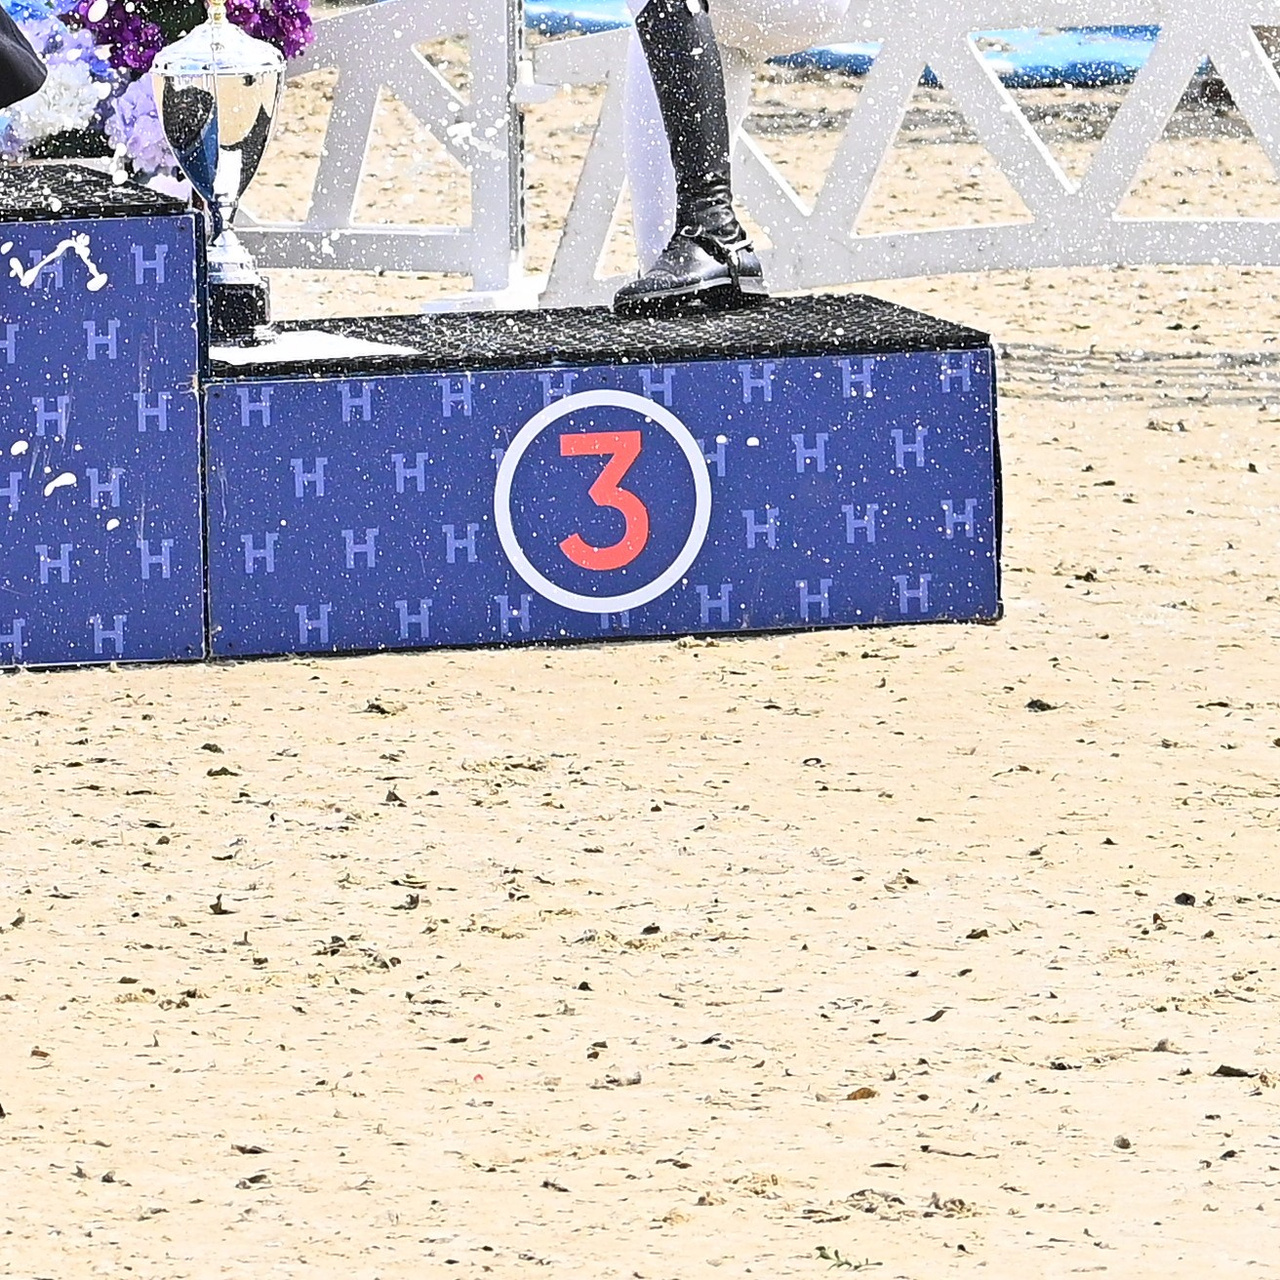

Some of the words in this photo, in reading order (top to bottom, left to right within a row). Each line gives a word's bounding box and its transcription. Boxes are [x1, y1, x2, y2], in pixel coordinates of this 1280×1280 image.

[30, 250, 65, 290] H
[132, 245, 169, 285] H
[84, 320, 121, 361] H
[538, 372, 576, 407] H
[639, 367, 676, 407] H
[739, 363, 778, 404] H
[840, 358, 877, 398] H
[940, 354, 974, 394] H
[33, 395, 72, 437] H
[134, 391, 172, 433] H
[238, 388, 275, 427] H
[338, 383, 375, 423] H
[437, 379, 476, 418] H
[792, 434, 830, 474] H
[892, 428, 929, 469] H
[87, 467, 126, 509] H
[292, 458, 329, 499] H
[392, 453, 429, 494] H
[559, 430, 650, 570] 3
[942, 499, 978, 540] H
[443, 524, 480, 564] H
[743, 509, 780, 550] H
[842, 504, 880, 544] H
[36, 544, 74, 585] H
[137, 539, 175, 580] H
[242, 534, 280, 574] H
[342, 528, 380, 569] H
[697, 585, 734, 624] H
[796, 580, 833, 620] H
[894, 574, 933, 614] H
[91, 616, 128, 655] H
[296, 604, 333, 645] H
[396, 599, 433, 639] H
[496, 595, 534, 636] H
